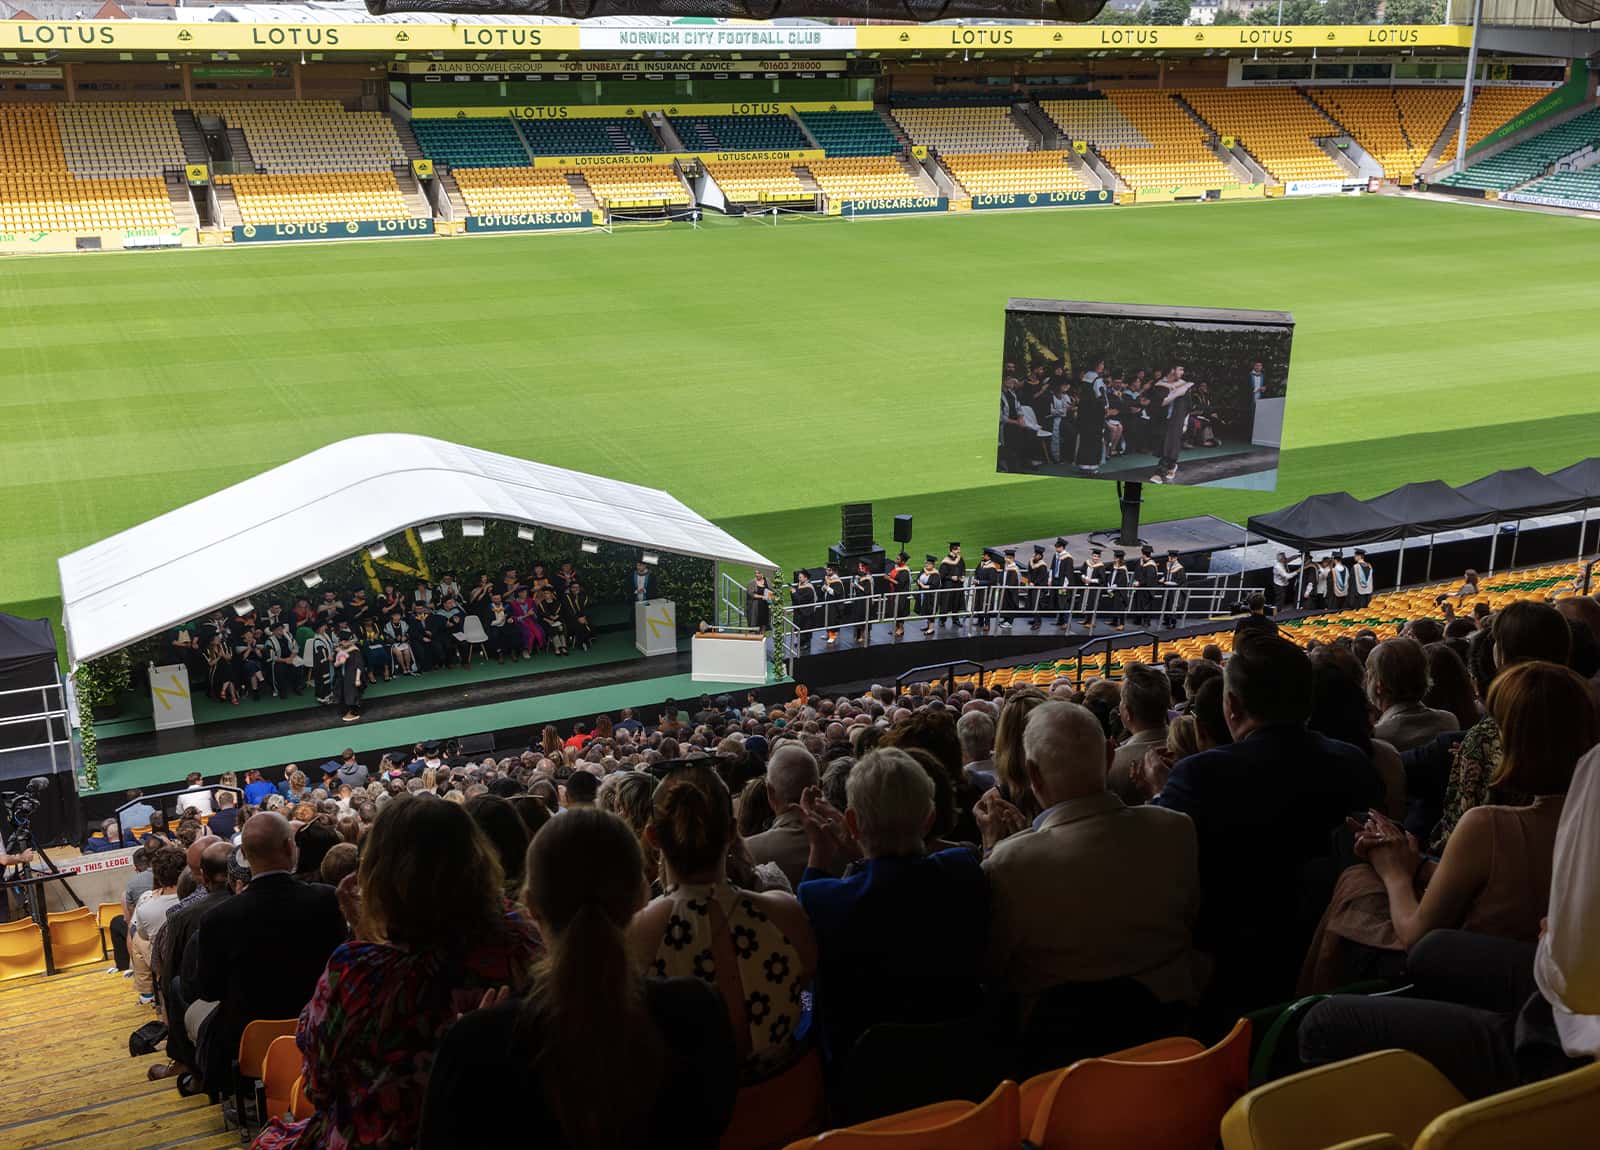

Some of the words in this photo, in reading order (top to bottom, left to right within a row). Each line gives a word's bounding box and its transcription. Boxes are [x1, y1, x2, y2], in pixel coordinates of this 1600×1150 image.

[18, 25, 115, 44] LOTUS
[252, 27, 339, 45] LOTUS
[463, 28, 542, 45] LOTUS
[619, 31, 680, 44] NORWICH
[684, 31, 714, 44] CITY
[717, 31, 784, 44] FOOTBALL
[788, 31, 822, 44] CLUB
[952, 30, 1013, 44] LOTUS
[1101, 30, 1158, 44] LOTUS
[1240, 30, 1293, 43] LOTUS
[1368, 29, 1419, 42] LOTUS
[437, 63, 463, 72] ALAN
[466, 63, 506, 72] BOSWELL
[509, 63, 543, 72] GROUP
[644, 62, 695, 71] INSURANCE
[792, 62, 822, 70] 218000
[514, 107, 568, 118] LOTUS
[731, 103, 780, 115] LOTUS
[575, 155, 653, 166] LOTUSCARS.COM
[717, 152, 790, 161] LOTUSCARS.COM
[978, 194, 1015, 206] LOTUS
[1050, 190, 1086, 202] LOTUS
[851, 196, 938, 211] LOTUSCARS.COM
[377, 218, 427, 232] LOTUS
[478, 213, 582, 226] LOTUSCARS.COM
[275, 223, 328, 236] LOTUS
[84, 862, 103, 872] THIS
[105, 857, 129, 868] LEDGE
